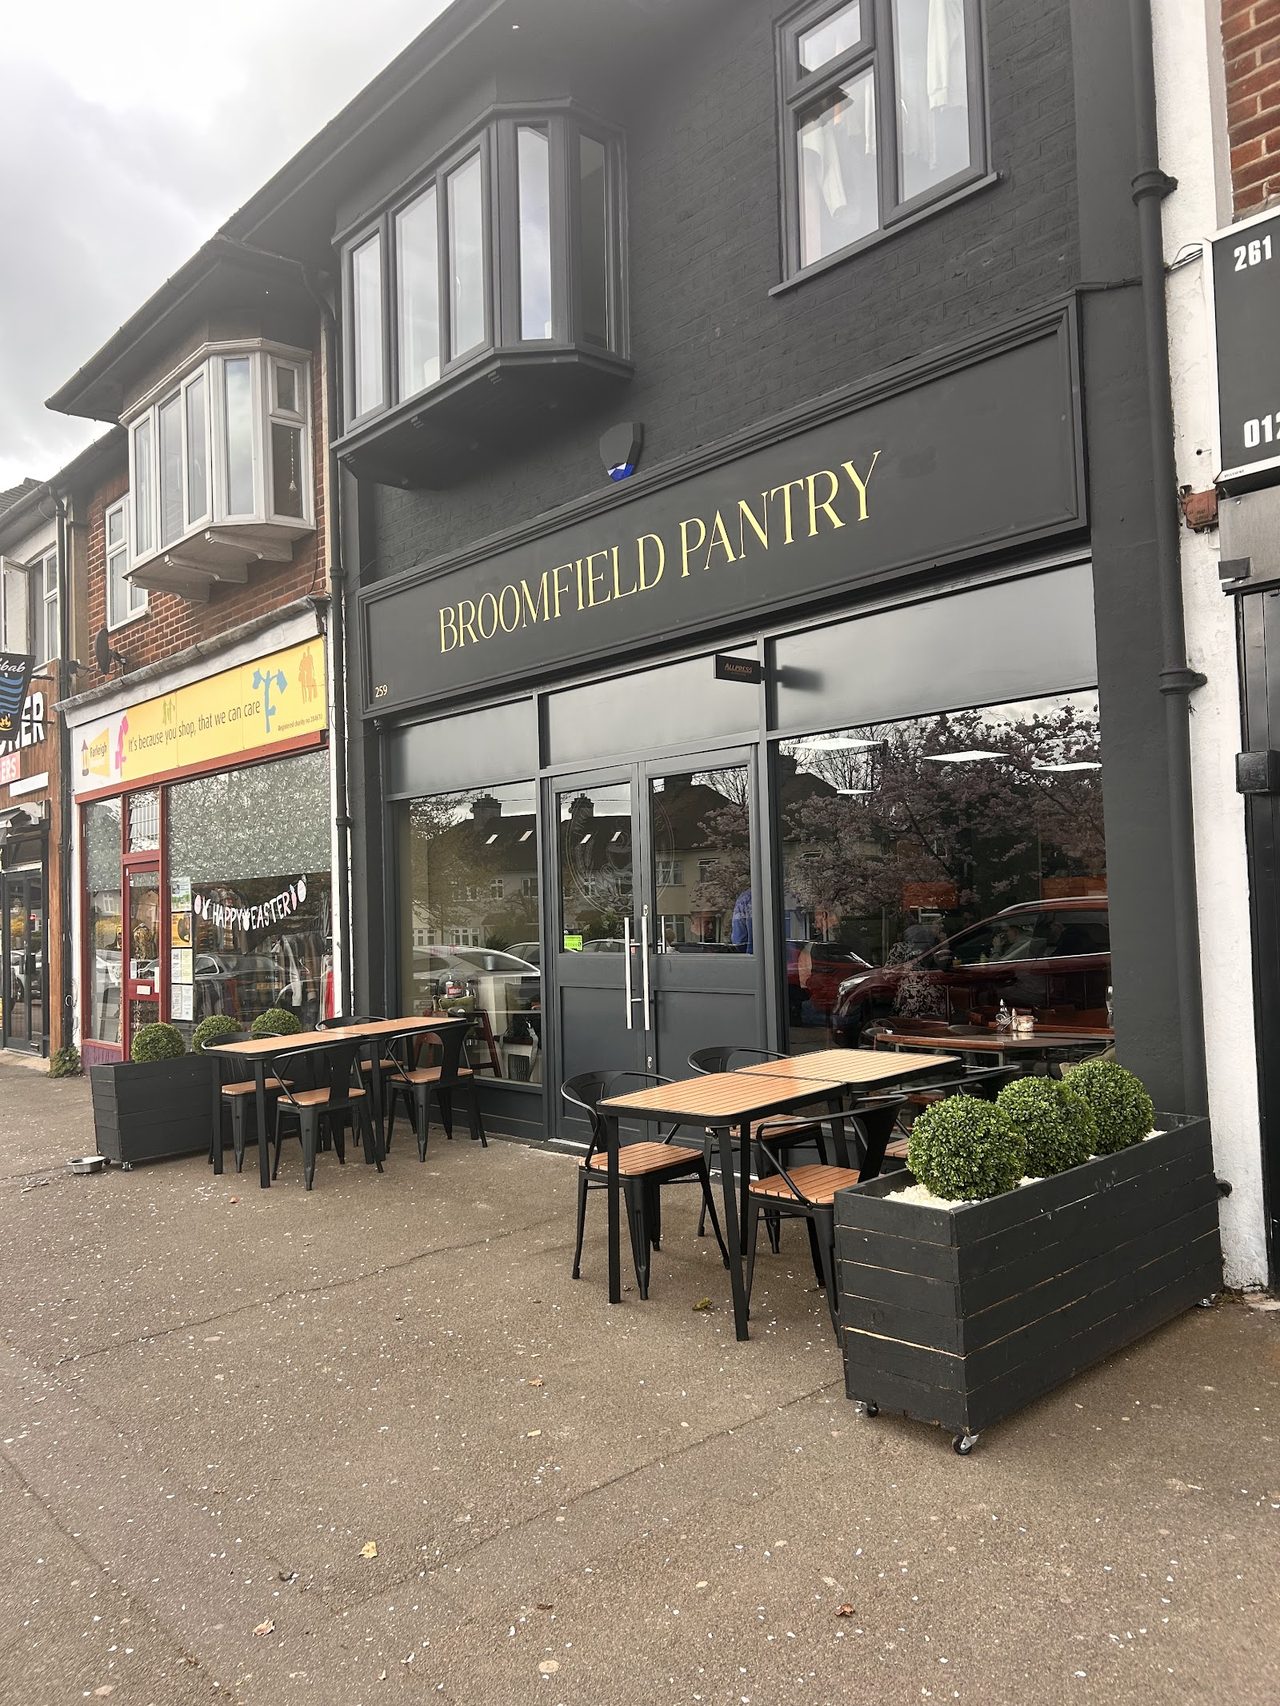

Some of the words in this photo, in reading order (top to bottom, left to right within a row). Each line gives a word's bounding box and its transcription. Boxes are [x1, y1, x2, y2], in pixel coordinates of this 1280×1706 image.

[1233, 235, 1272, 272] 261
[438, 533, 666, 653] BROOMFIELD
[679, 449, 882, 578] PANTRY
[0, 658, 26, 673] bab
[375, 684, 388, 698] 259
[138, 731, 163, 750] because
[164, 727, 177, 745] you
[178, 719, 197, 738] shop,
[198, 713, 213, 731] that
[214, 710, 226, 726] we
[227, 704, 242, 723] can
[243, 700, 261, 718] care
[212, 902, 243, 931] HAPPY
[250, 891, 292, 930] EASTER
